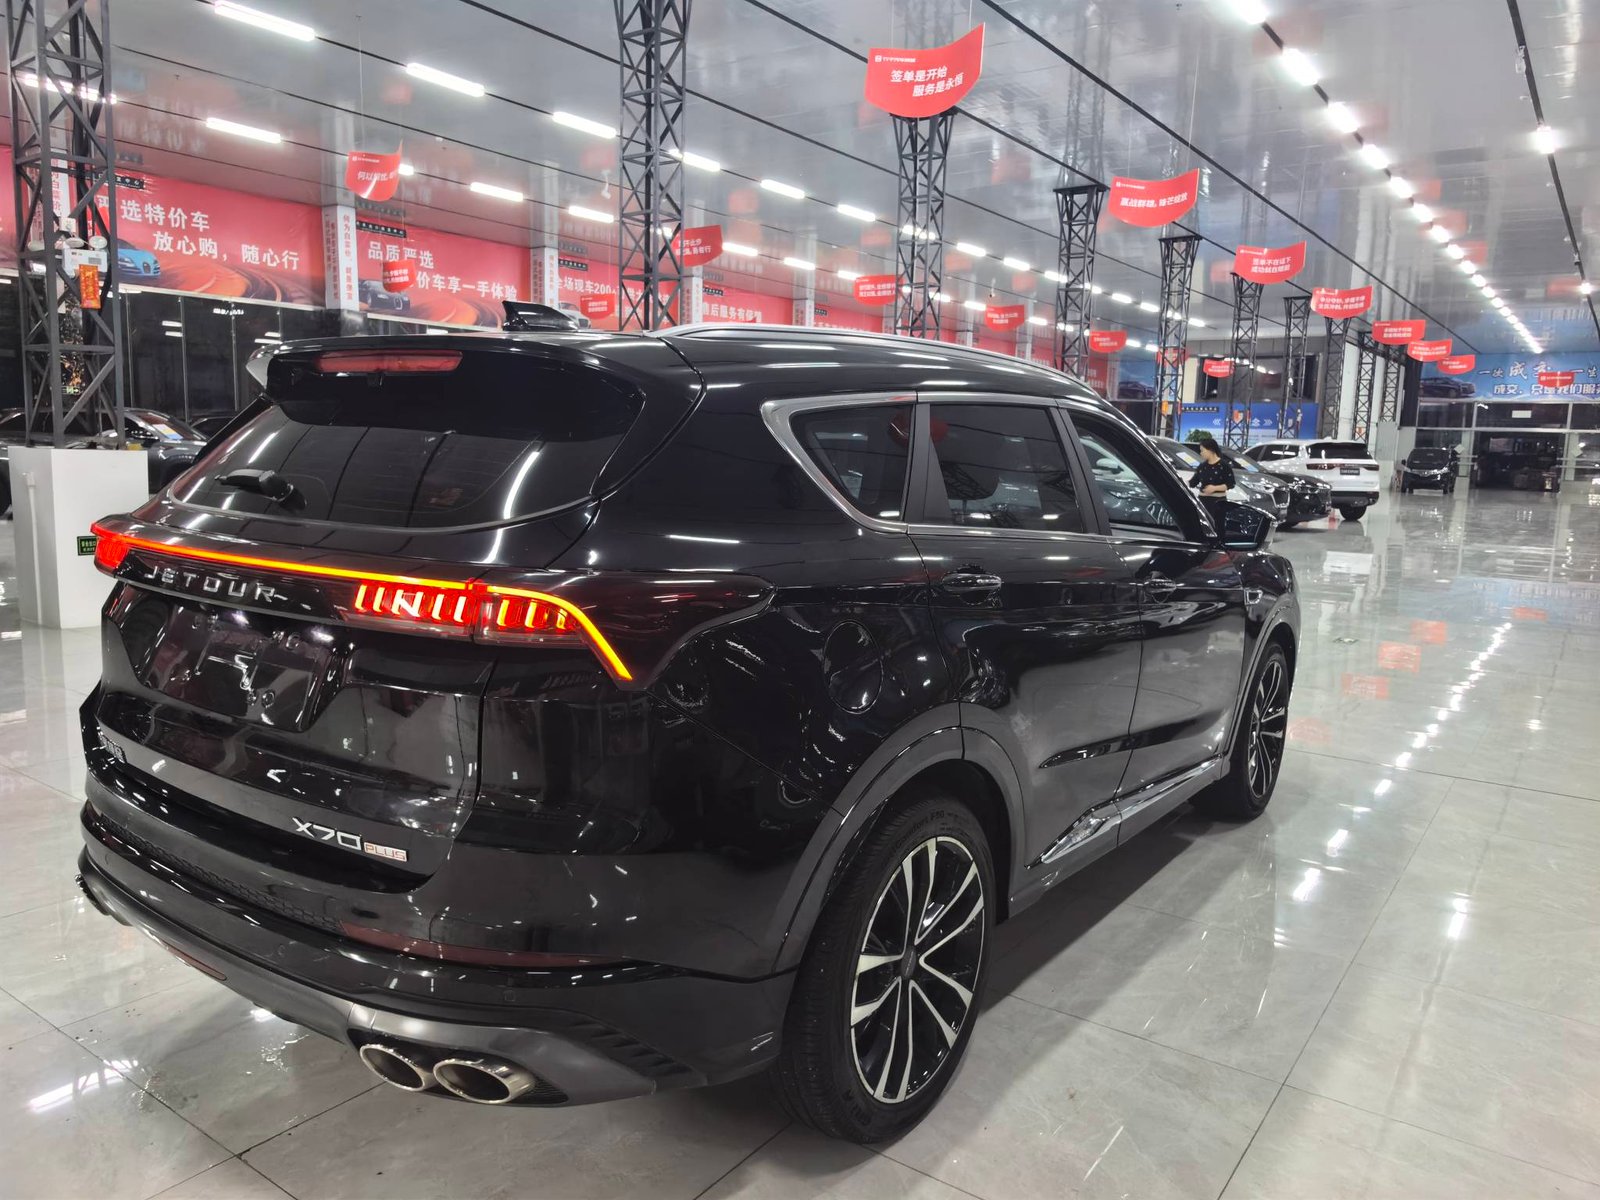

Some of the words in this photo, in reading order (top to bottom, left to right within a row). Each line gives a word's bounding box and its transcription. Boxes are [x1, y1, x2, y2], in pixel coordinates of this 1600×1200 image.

[890, 65, 948, 82] 签单是开始
[912, 72, 964, 97] 服务是永恒
[153, 230, 299, 271] 放心购，随心行
[367, 240, 435, 269] 品质严选
[410, 271, 518, 301] 价车享一手体验
[143, 565, 275, 603] JETOUR
[292, 817, 362, 851] X70
[364, 842, 407, 862] PLUS
